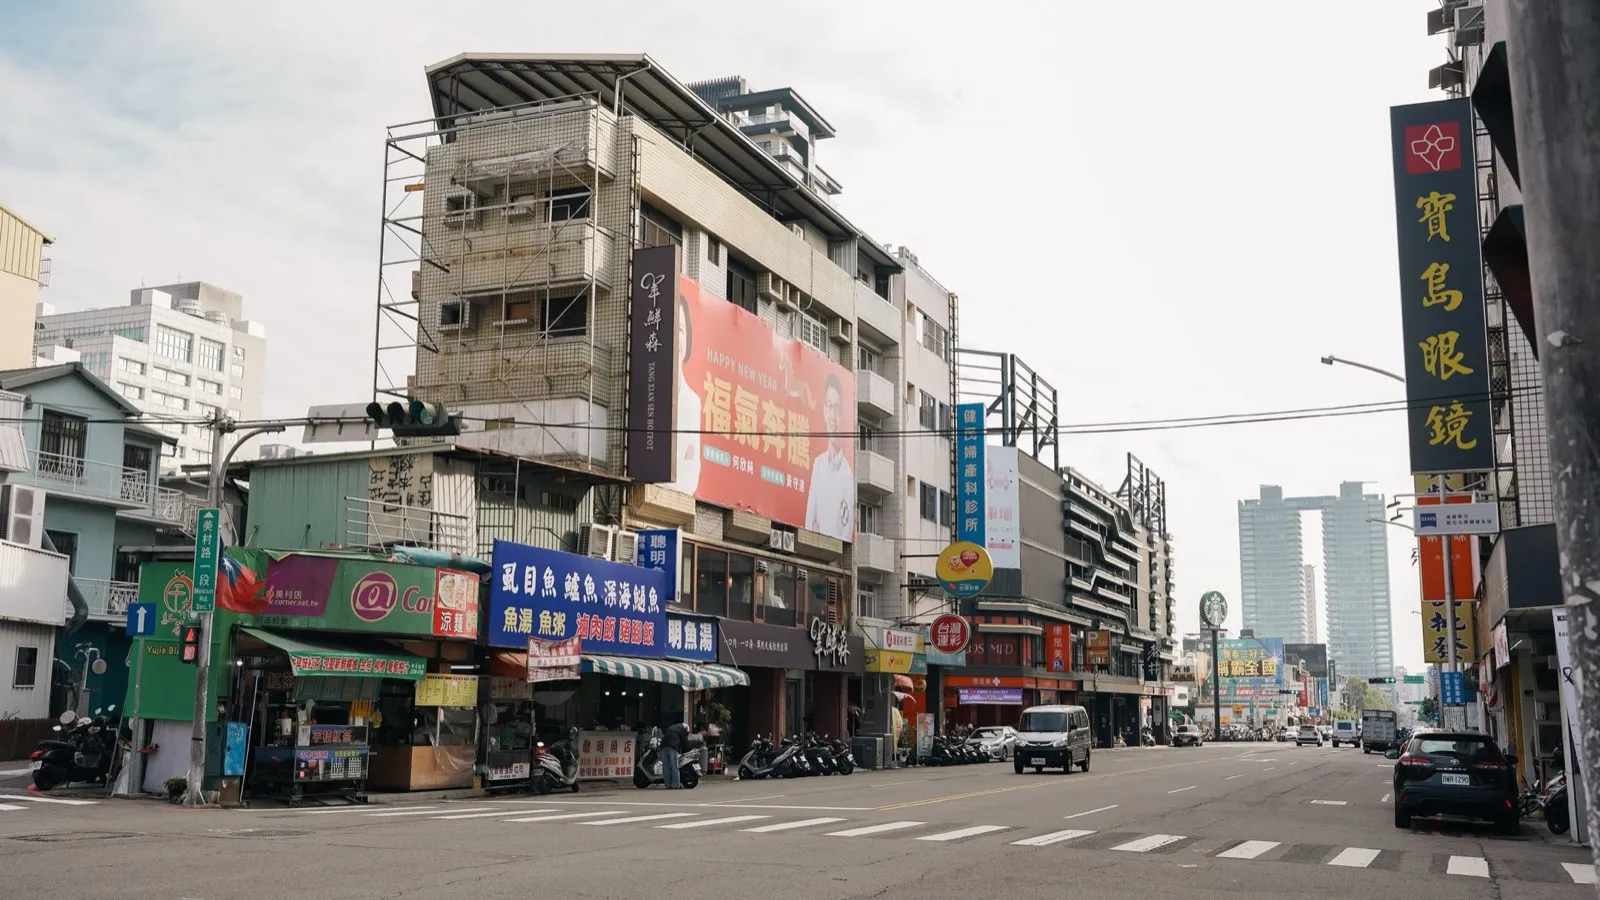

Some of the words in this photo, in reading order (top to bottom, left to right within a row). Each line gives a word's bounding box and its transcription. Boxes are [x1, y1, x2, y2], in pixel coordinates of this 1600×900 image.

[1416, 191, 1477, 450] 寶島眼鏡
[648, 362, 656, 382] YANG
[707, 347, 735, 373] HAPPY
[738, 362, 756, 383] NEW
[758, 371, 777, 393] YEAR
[702, 370, 810, 471] 福氣奔騰
[963, 409, 978, 532] 健民婦產科診所
[199, 520, 213, 586] 美村路一段
[650, 535, 666, 571] 聰明
[502, 562, 557, 599] 虱目魚
[564, 572, 598, 603] 鱸魚
[440, 611, 463, 632] 涼麵
[503, 607, 533, 634] 魚湯
[538, 610, 566, 637] 魚粥
[619, 617, 655, 646] 豬腳飯
[667, 620, 713, 652] 明魚湯
[938, 622, 961, 634] 台灣
[1088, 632, 1098, 646] P
[147, 646, 166, 655] Yujie
[937, 634, 961, 647] 運彩
